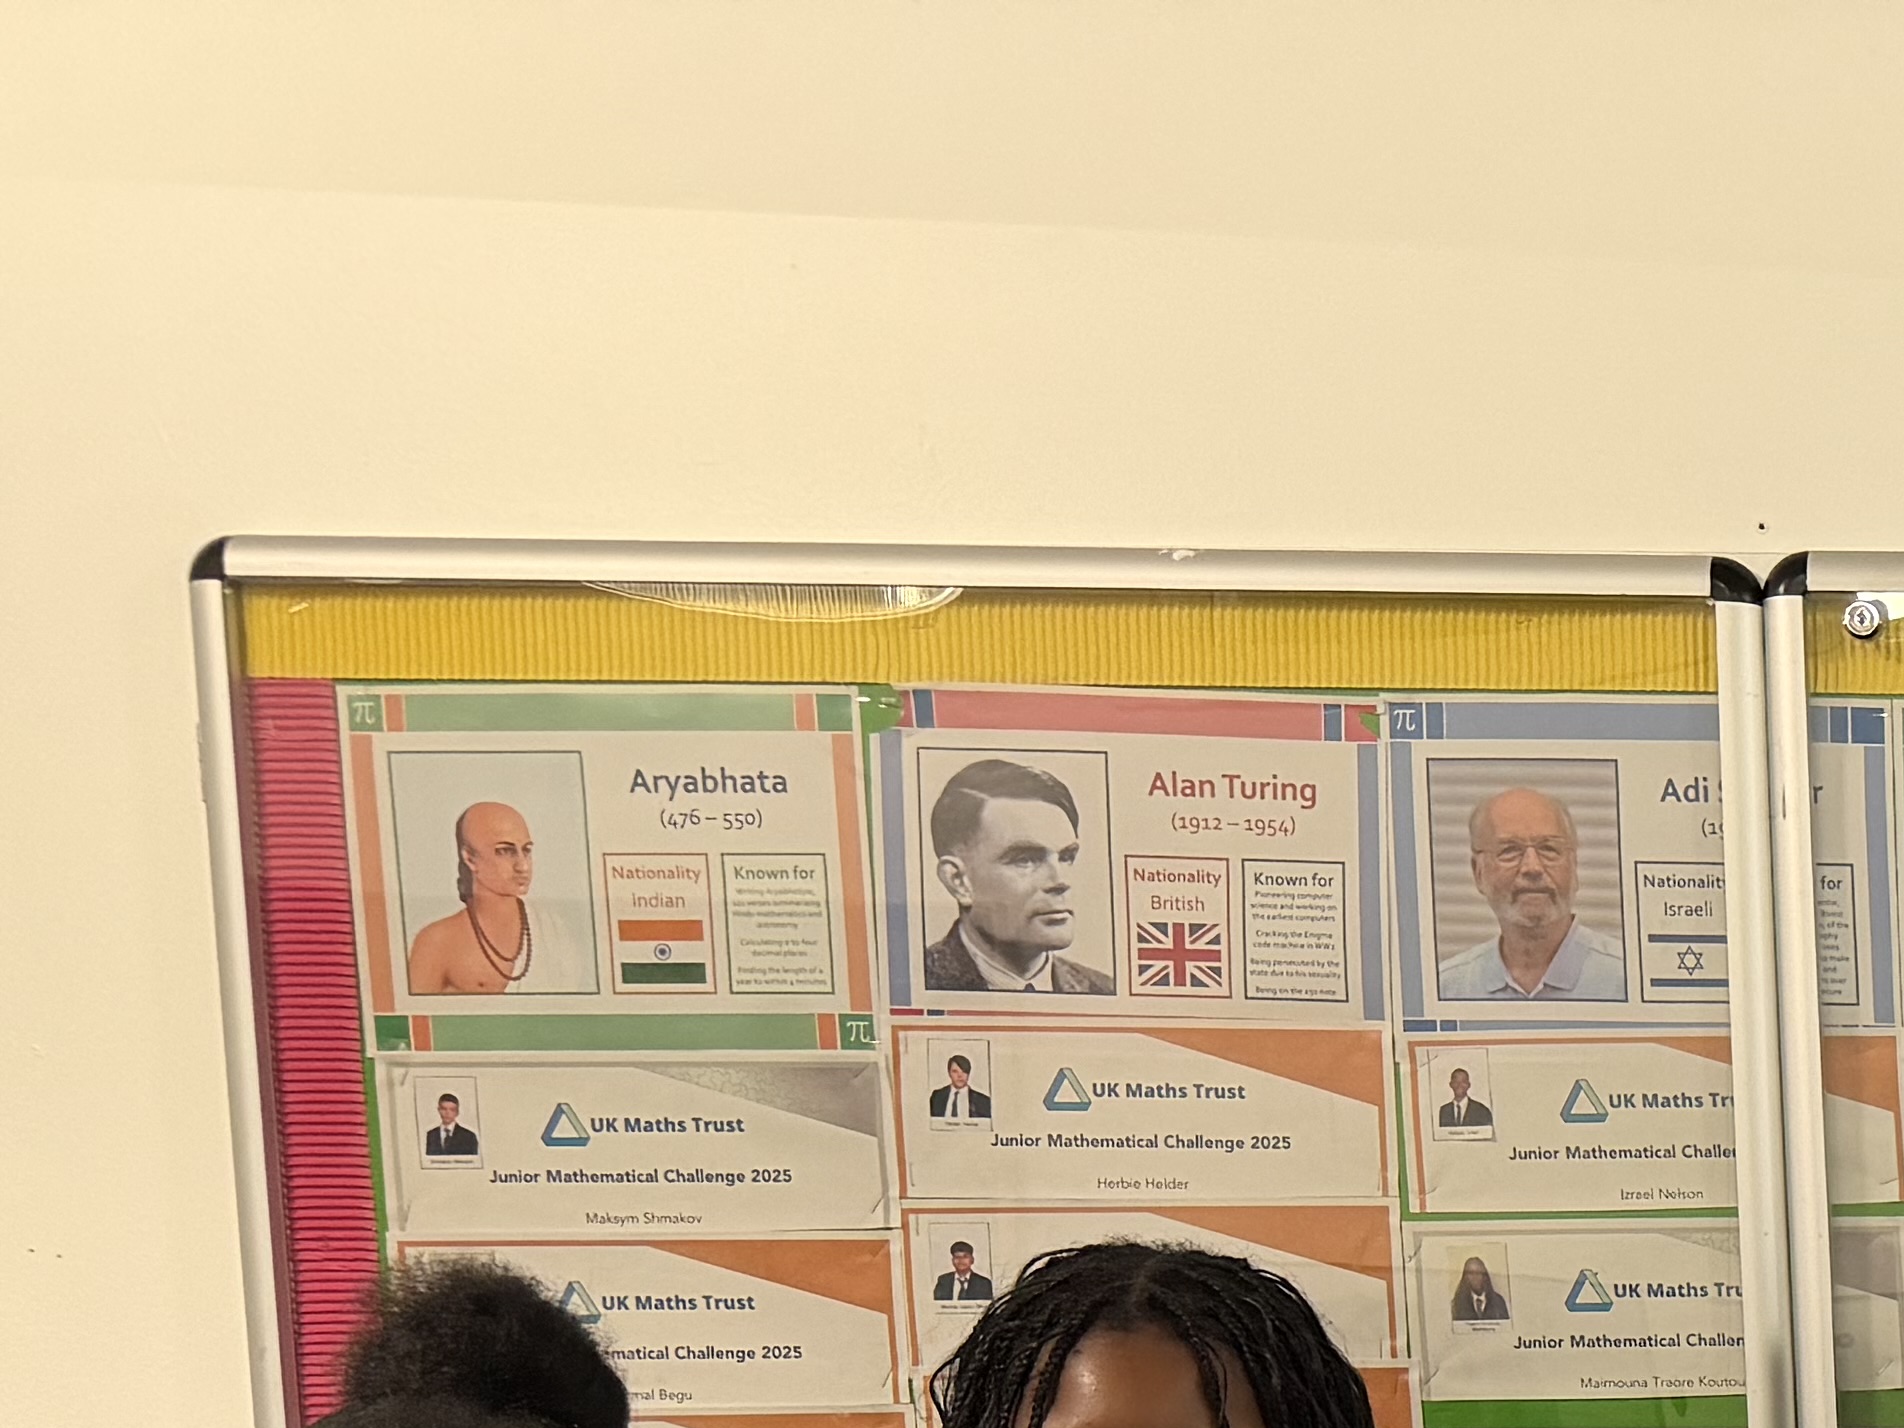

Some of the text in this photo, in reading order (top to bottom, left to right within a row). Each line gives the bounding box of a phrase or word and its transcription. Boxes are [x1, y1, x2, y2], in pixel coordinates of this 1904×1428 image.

[630, 766, 787, 801] Aryabhata
[1148, 771, 1316, 809] Alan Turing
[1660, 777, 1709, 803] Adi
[660, 809, 701, 829] (476
[723, 809, 762, 830] 550)
[1171, 812, 1222, 834] (1912
[1244, 816, 1295, 837] 1954)
[612, 865, 701, 884] Nationality
[734, 865, 815, 880] Known for
[632, 892, 685, 908] Indian
[1151, 895, 1205, 911] British
[1664, 901, 1712, 917] Israeli
[490, 1168, 792, 1186] Junior Mathematical Challenge 2025
[586, 1212, 702, 1227] Maksym Shmakov
